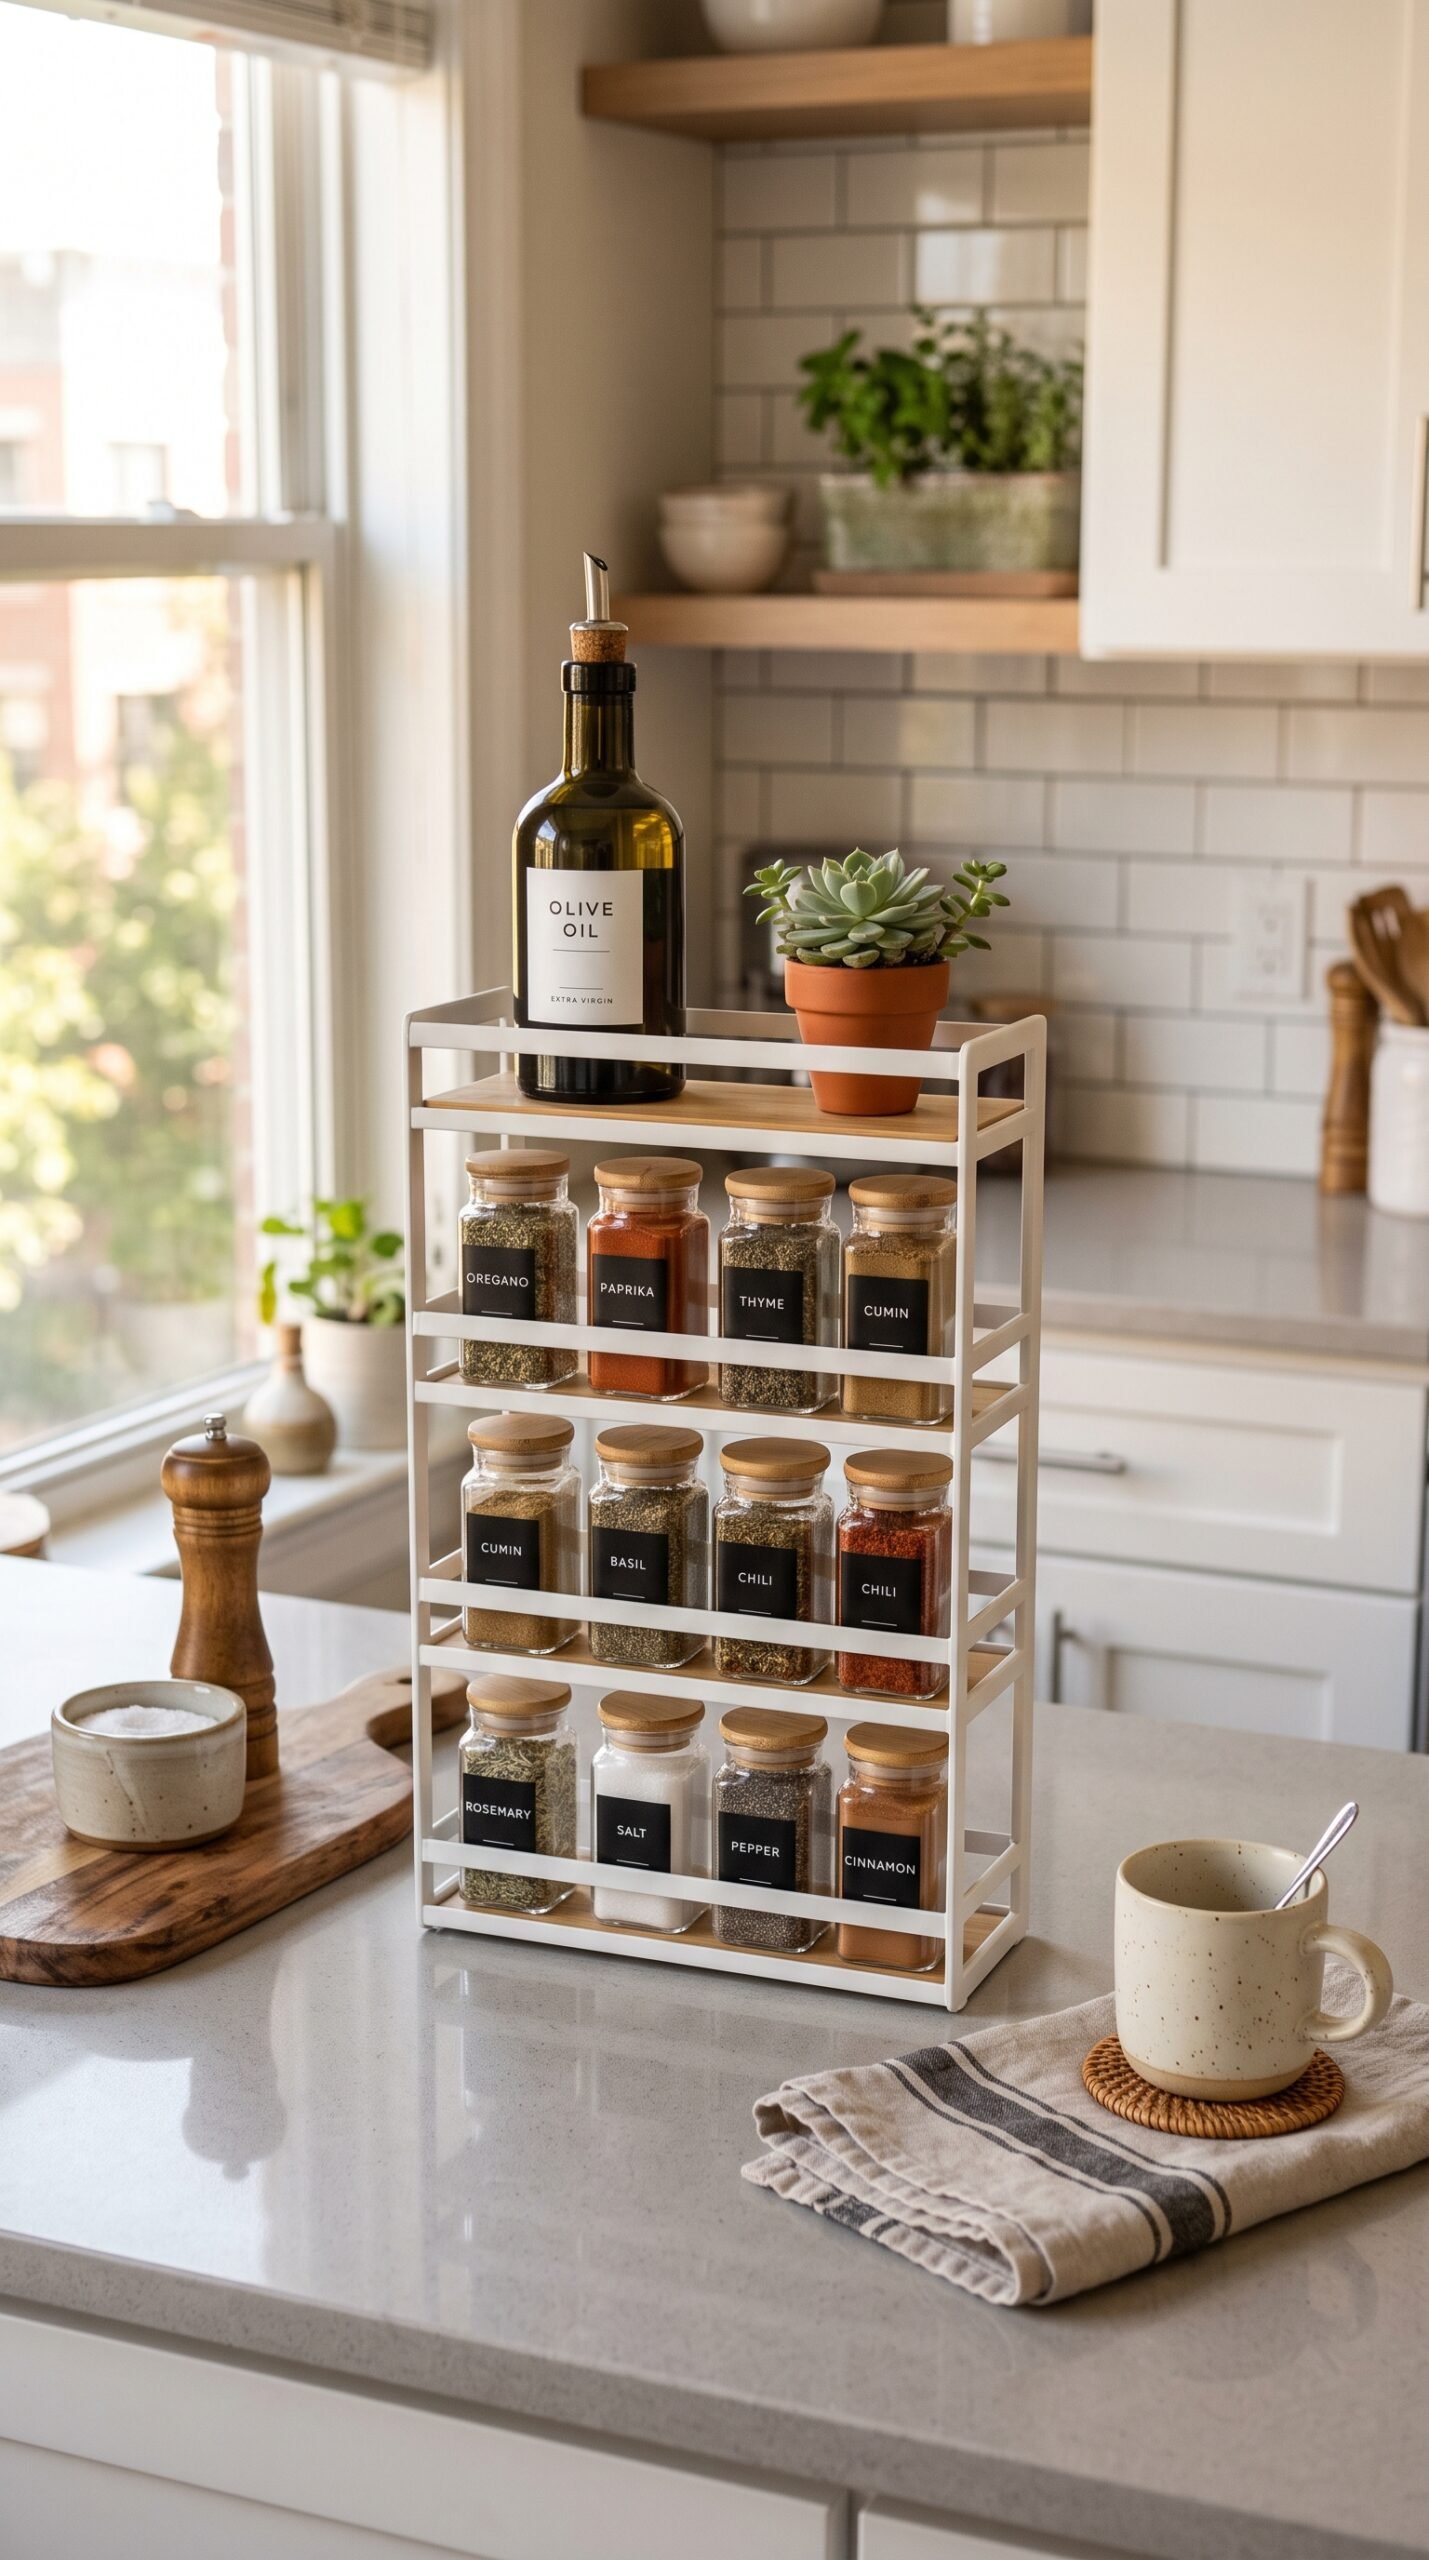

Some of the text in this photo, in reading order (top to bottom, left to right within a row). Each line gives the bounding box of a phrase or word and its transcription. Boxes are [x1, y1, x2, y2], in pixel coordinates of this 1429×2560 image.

[549, 900, 614, 917] OLIVE
[563, 923, 599, 939] OIL
[550, 995, 614, 1005] EXTRA VIRGIN
[465, 1271, 529, 1288] OREGANO
[600, 1282, 655, 1298] PAPRIKA
[739, 1295, 785, 1310] THYME
[863, 1305, 909, 1319] CUMIN
[480, 1542, 522, 1557] CUMIN
[610, 1555, 647, 1570] BASIL
[738, 1572, 772, 1586] CHILI
[861, 1583, 896, 1598] CHILI
[465, 1800, 531, 1820] ROSEMARY
[616, 1824, 647, 1839] SALT
[731, 1841, 780, 1858] PEPPER
[844, 1855, 916, 1875] CINNAMON
